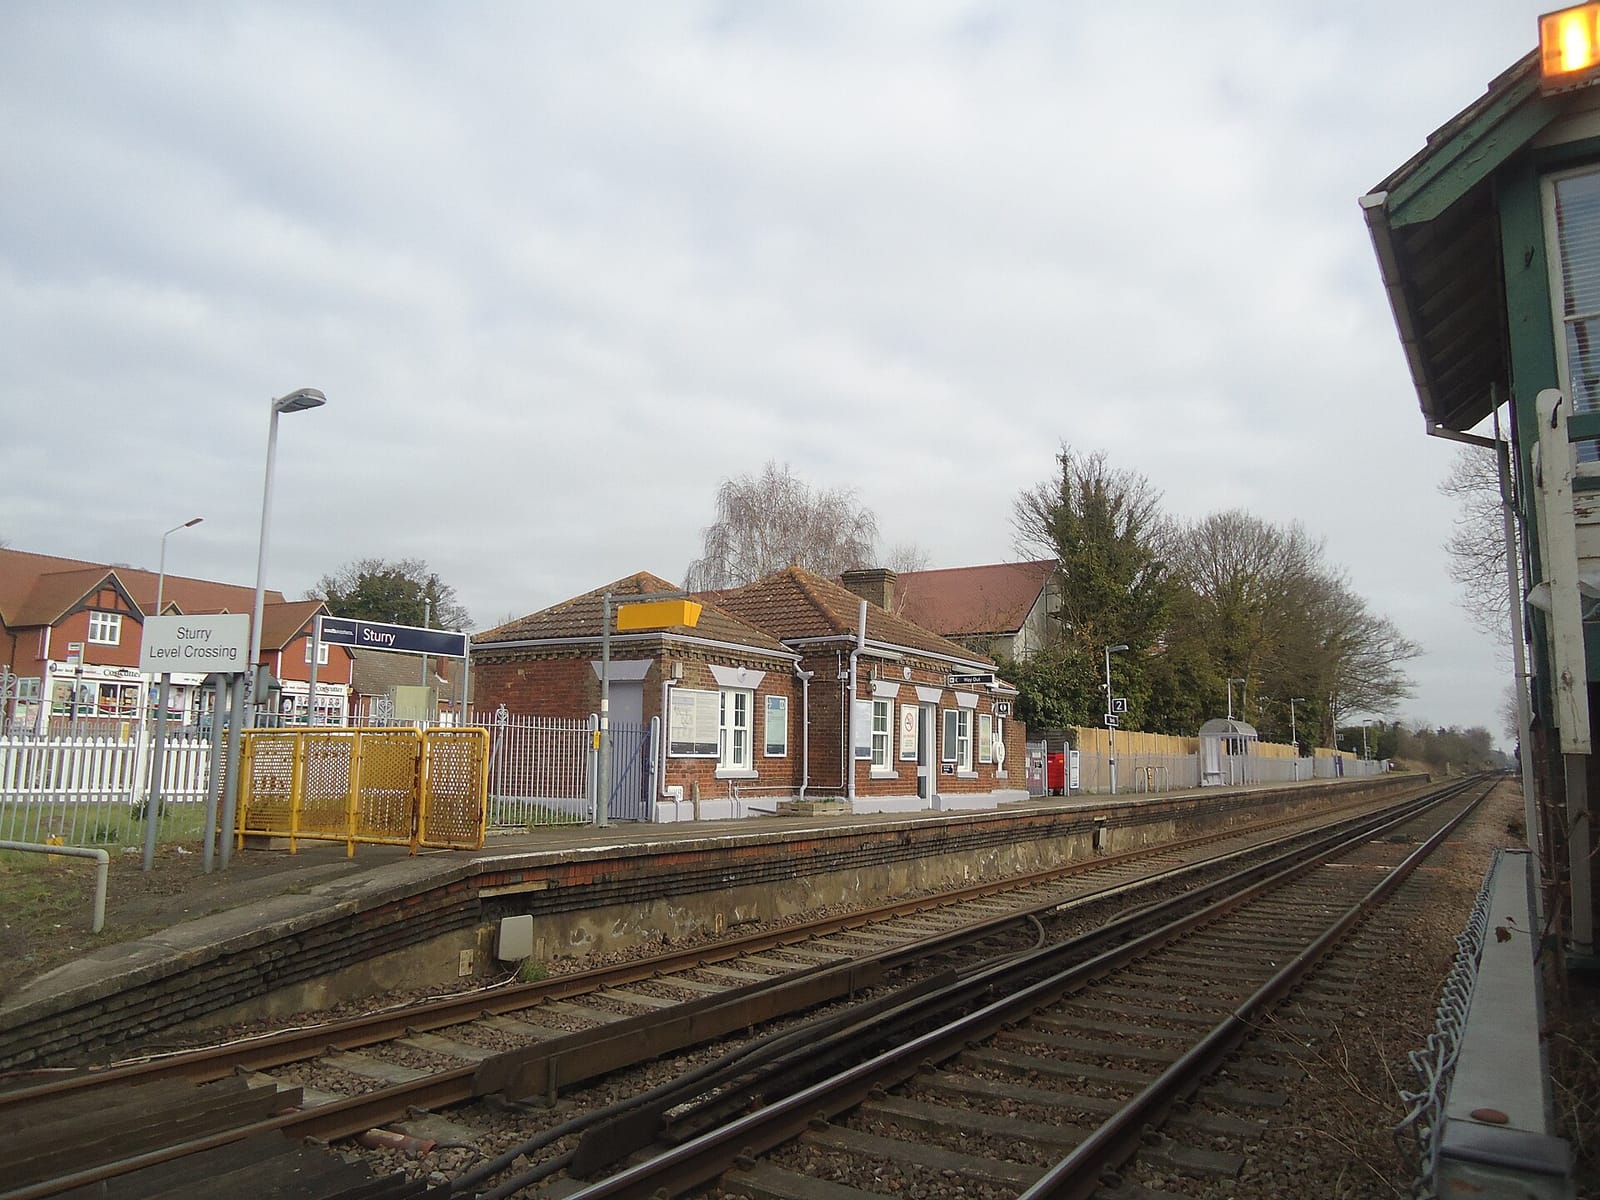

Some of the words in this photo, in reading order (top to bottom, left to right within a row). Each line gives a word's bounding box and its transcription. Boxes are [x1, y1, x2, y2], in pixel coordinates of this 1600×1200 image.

[176, 626, 212, 642] Sturry
[362, 627, 396, 647] Sturry
[149, 645, 181, 658] Level
[184, 645, 237, 660] Crossing
[1116, 701, 1123, 710] 2
